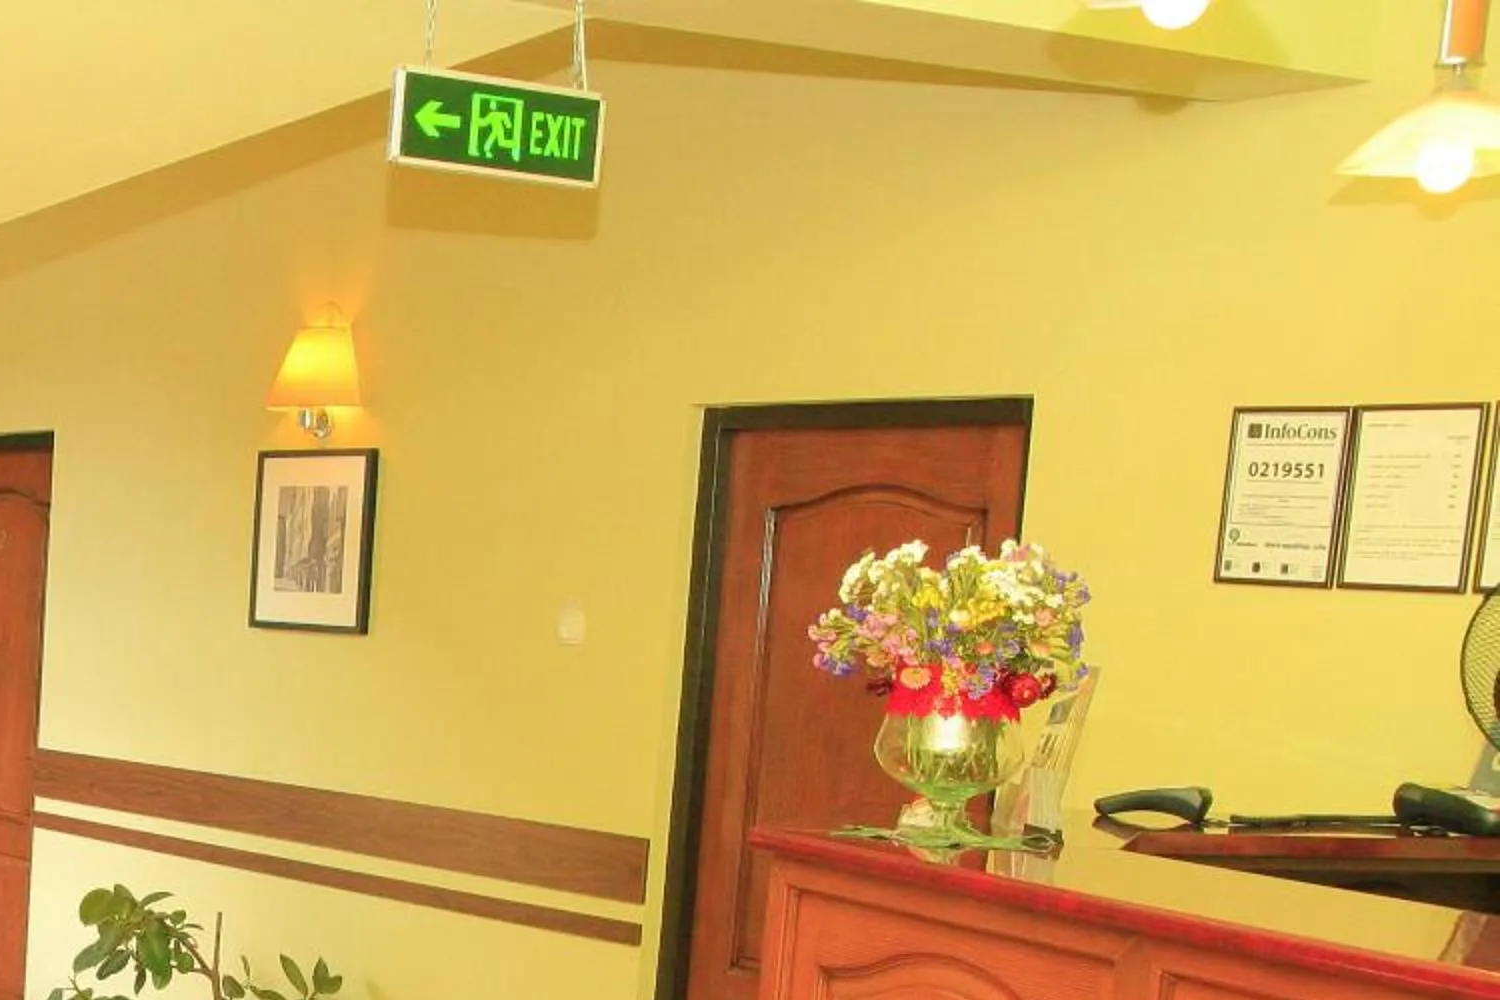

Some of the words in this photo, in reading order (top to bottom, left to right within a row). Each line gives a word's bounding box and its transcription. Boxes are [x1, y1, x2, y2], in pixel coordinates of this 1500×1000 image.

[529, 111, 586, 160] EXIT
[1264, 423, 1337, 440] InfoCons
[1248, 461, 1325, 479] 0219551
